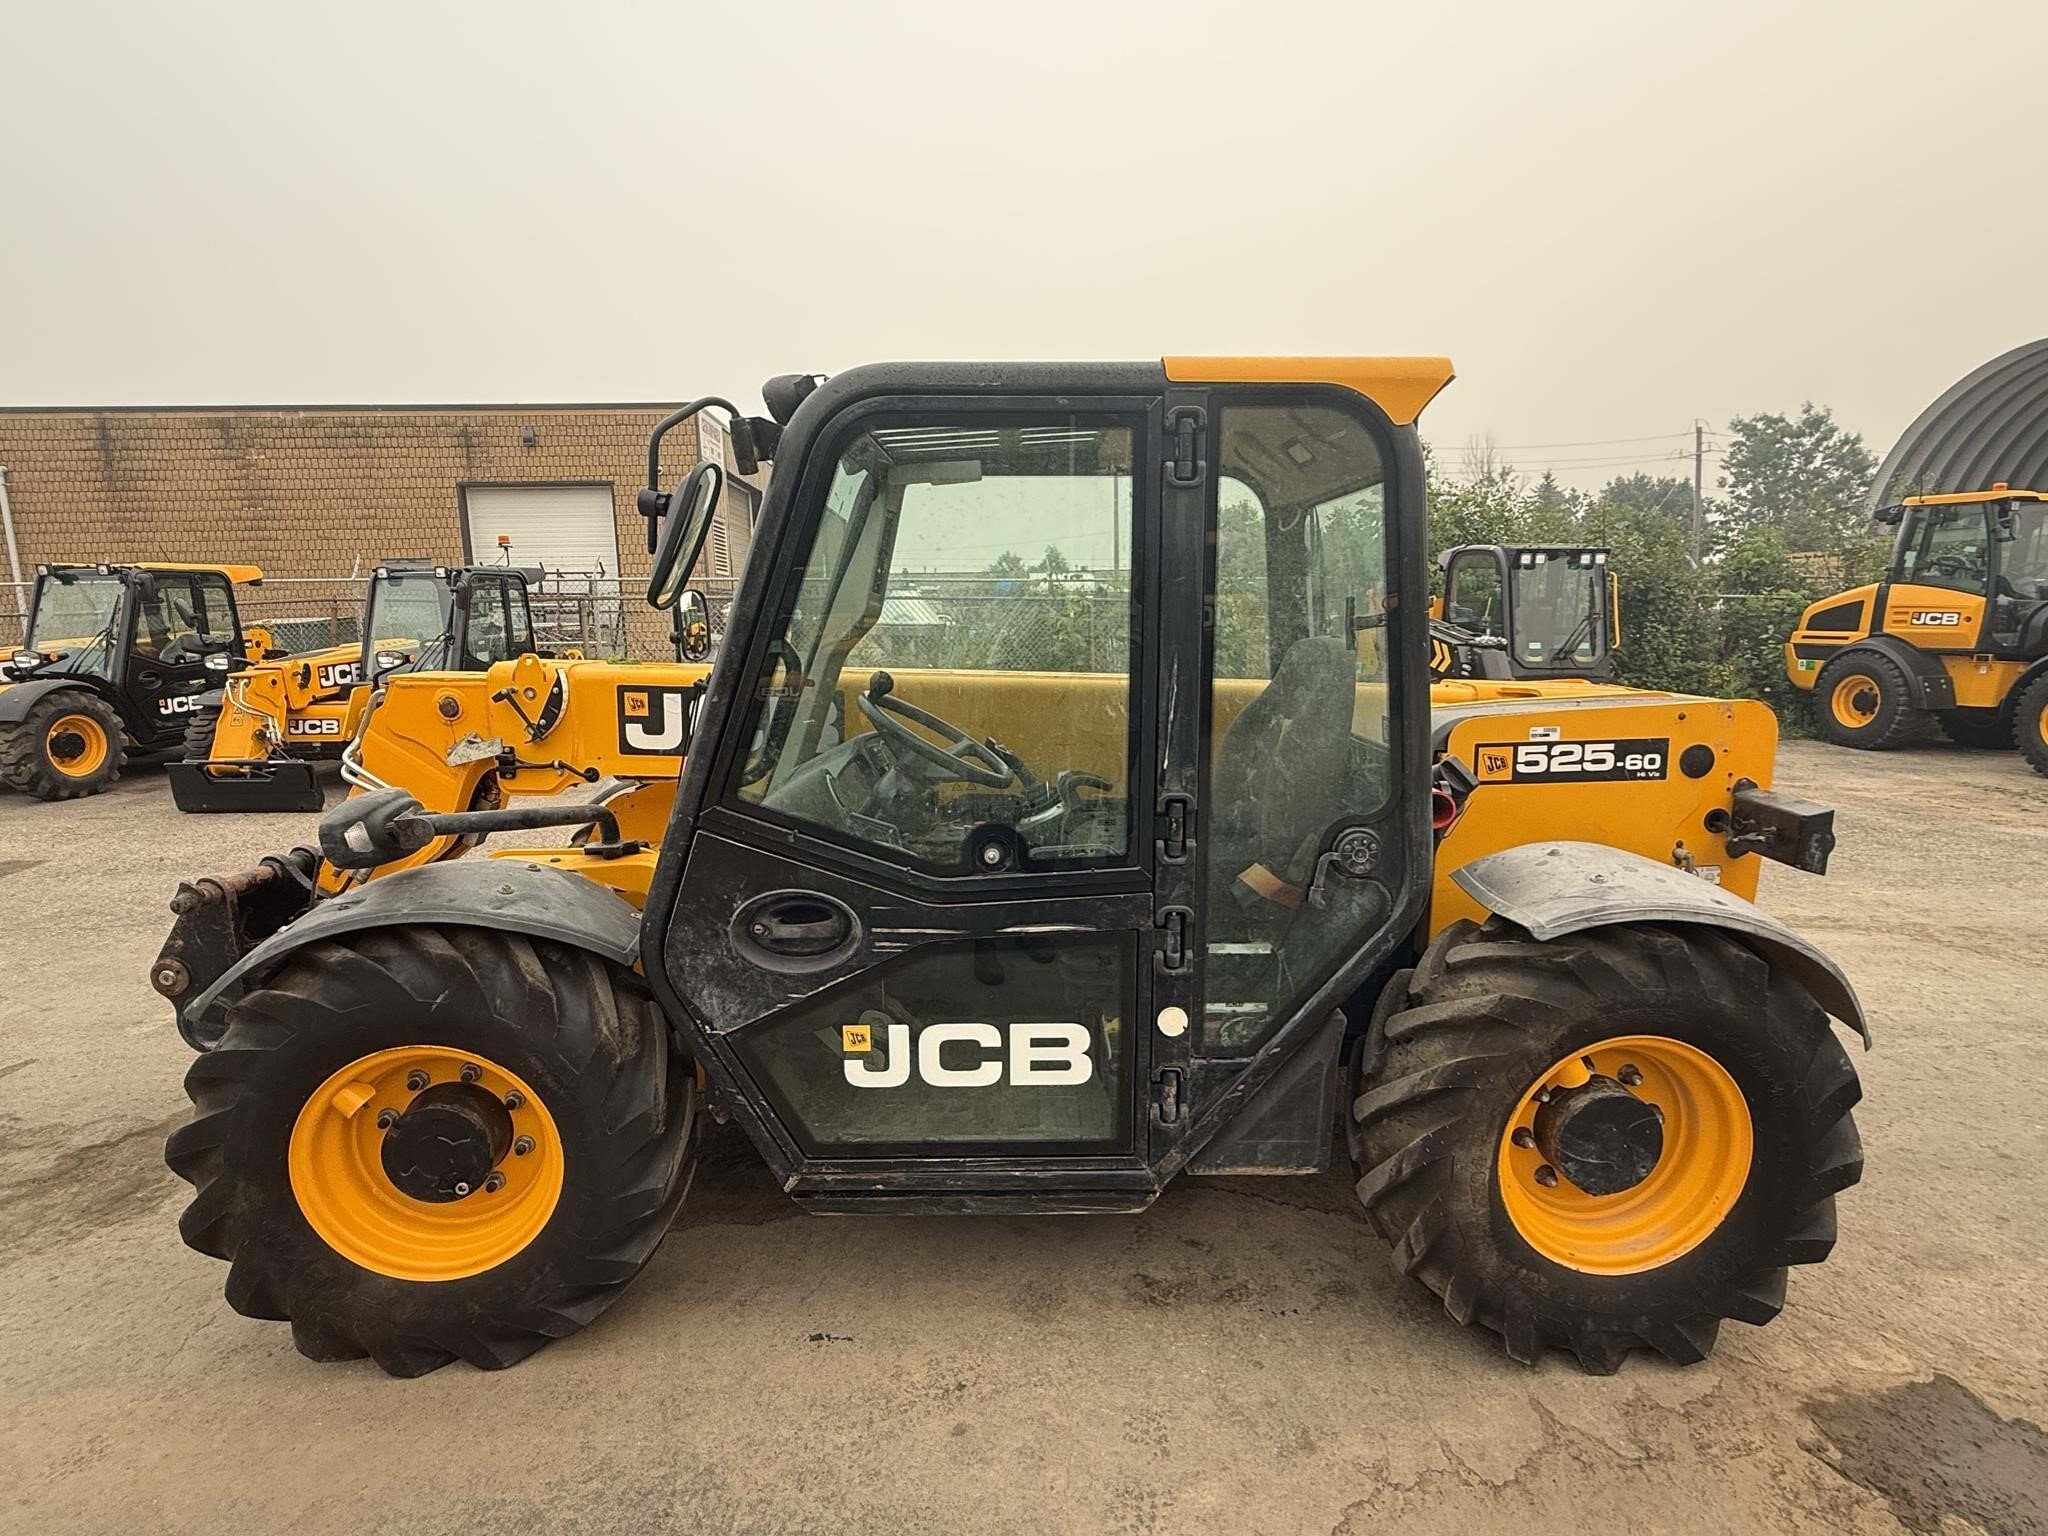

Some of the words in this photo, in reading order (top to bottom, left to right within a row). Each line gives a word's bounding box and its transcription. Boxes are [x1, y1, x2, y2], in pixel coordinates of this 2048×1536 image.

[1912, 612, 1959, 625] JCB
[289, 719, 339, 734] JCB
[1486, 755, 1507, 772] JCB
[1515, 743, 1662, 773] 525-60
[843, 1023, 1093, 1088] JCB
